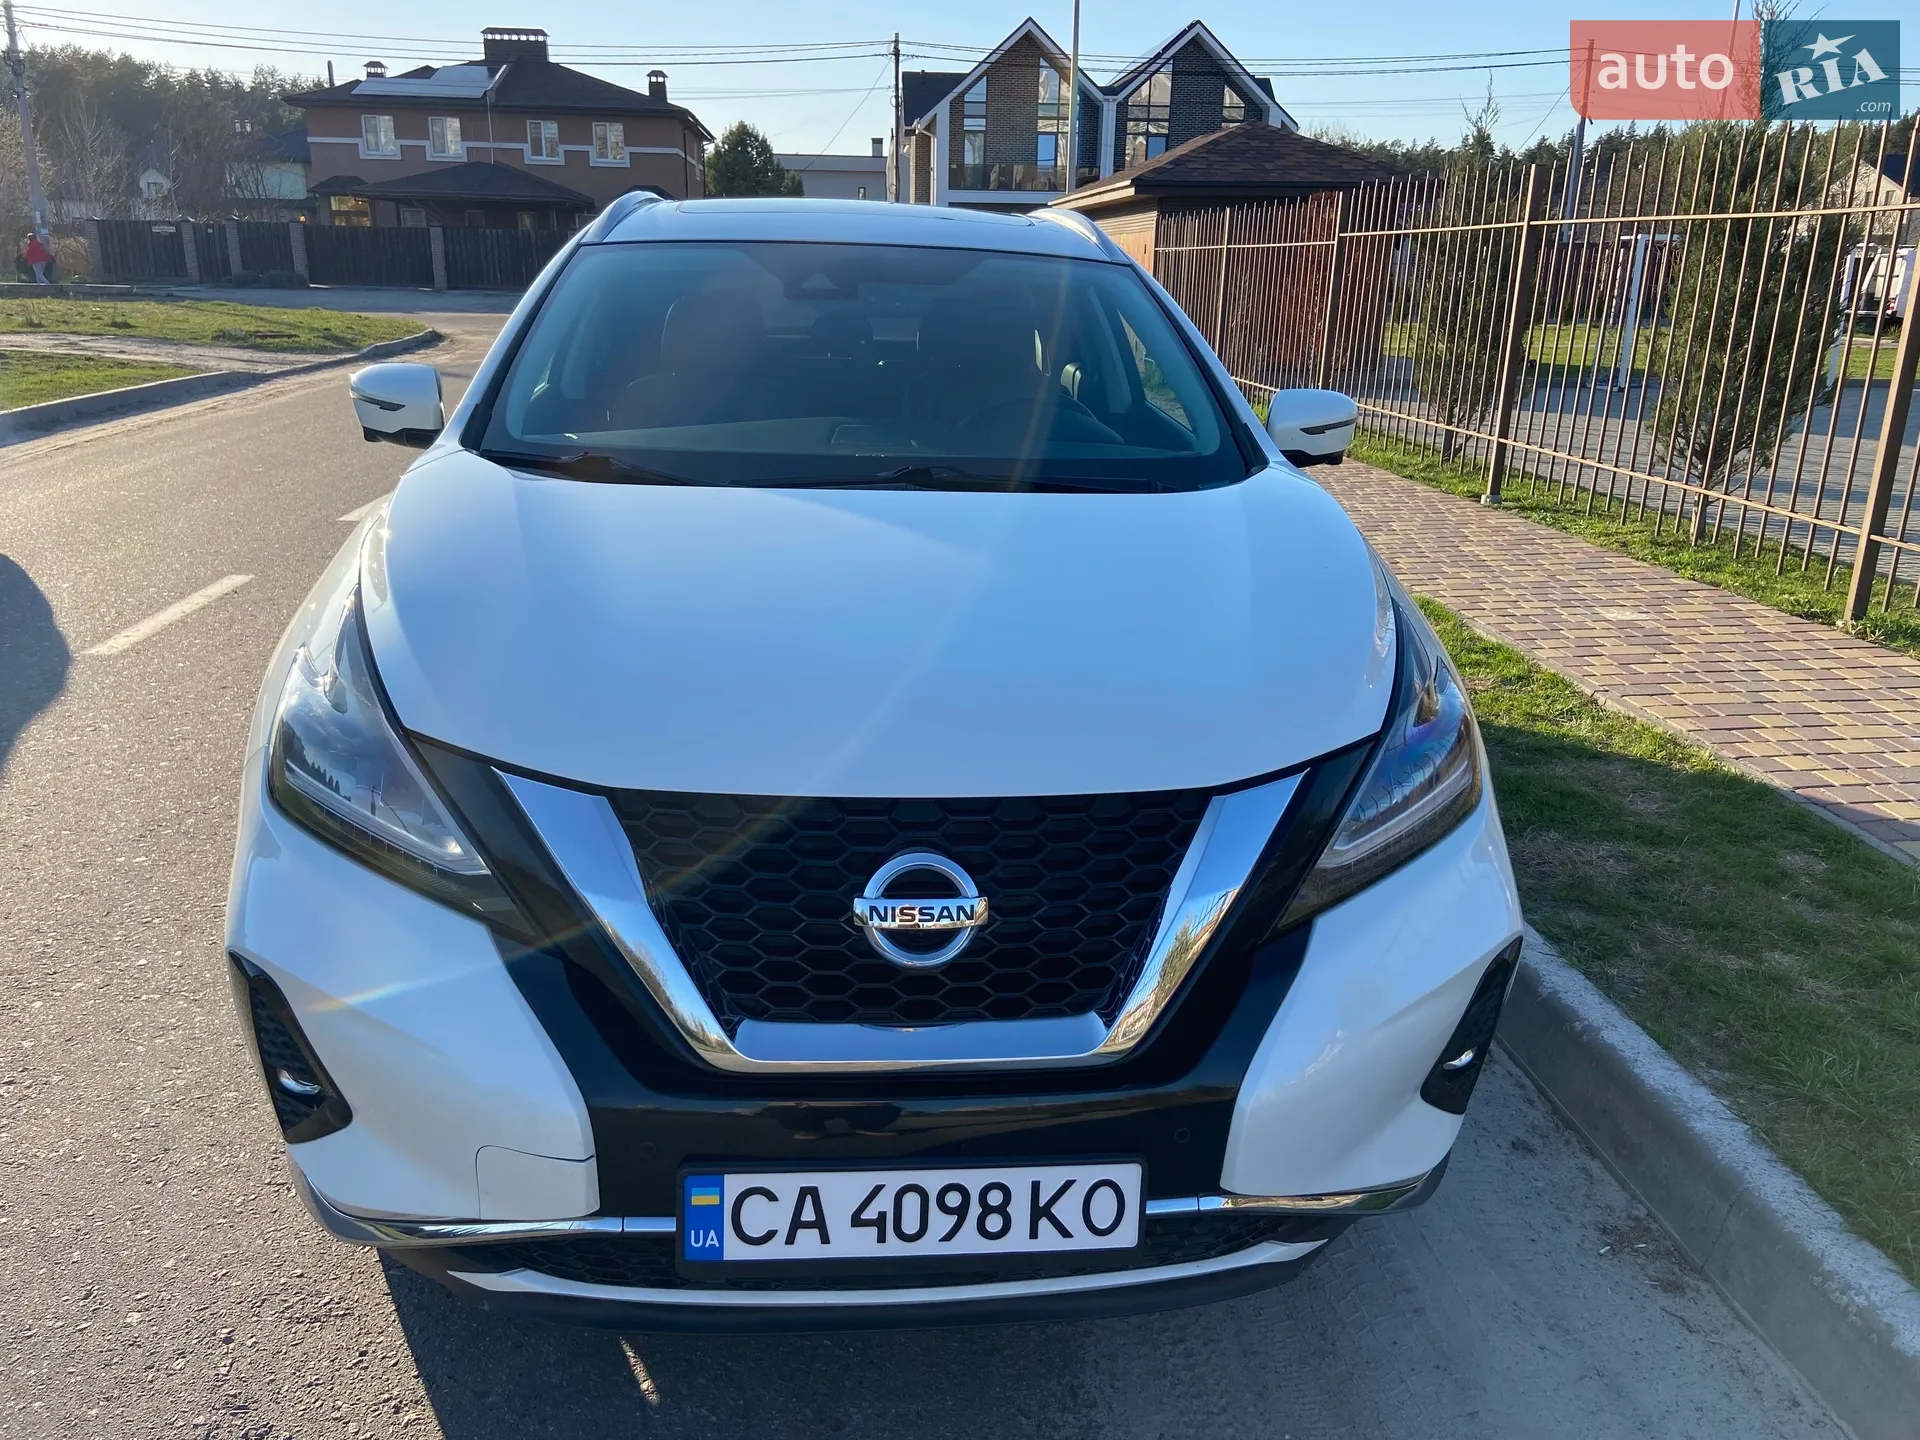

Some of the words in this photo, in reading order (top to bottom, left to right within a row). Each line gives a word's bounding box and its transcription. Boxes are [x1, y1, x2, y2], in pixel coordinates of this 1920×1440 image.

[869, 905, 974, 922] NISSAN
[731, 1186, 830, 1246] CA
[851, 1182, 1012, 1243] 4098
[1029, 1178, 1126, 1239] KO
[690, 1230, 719, 1248] UA
